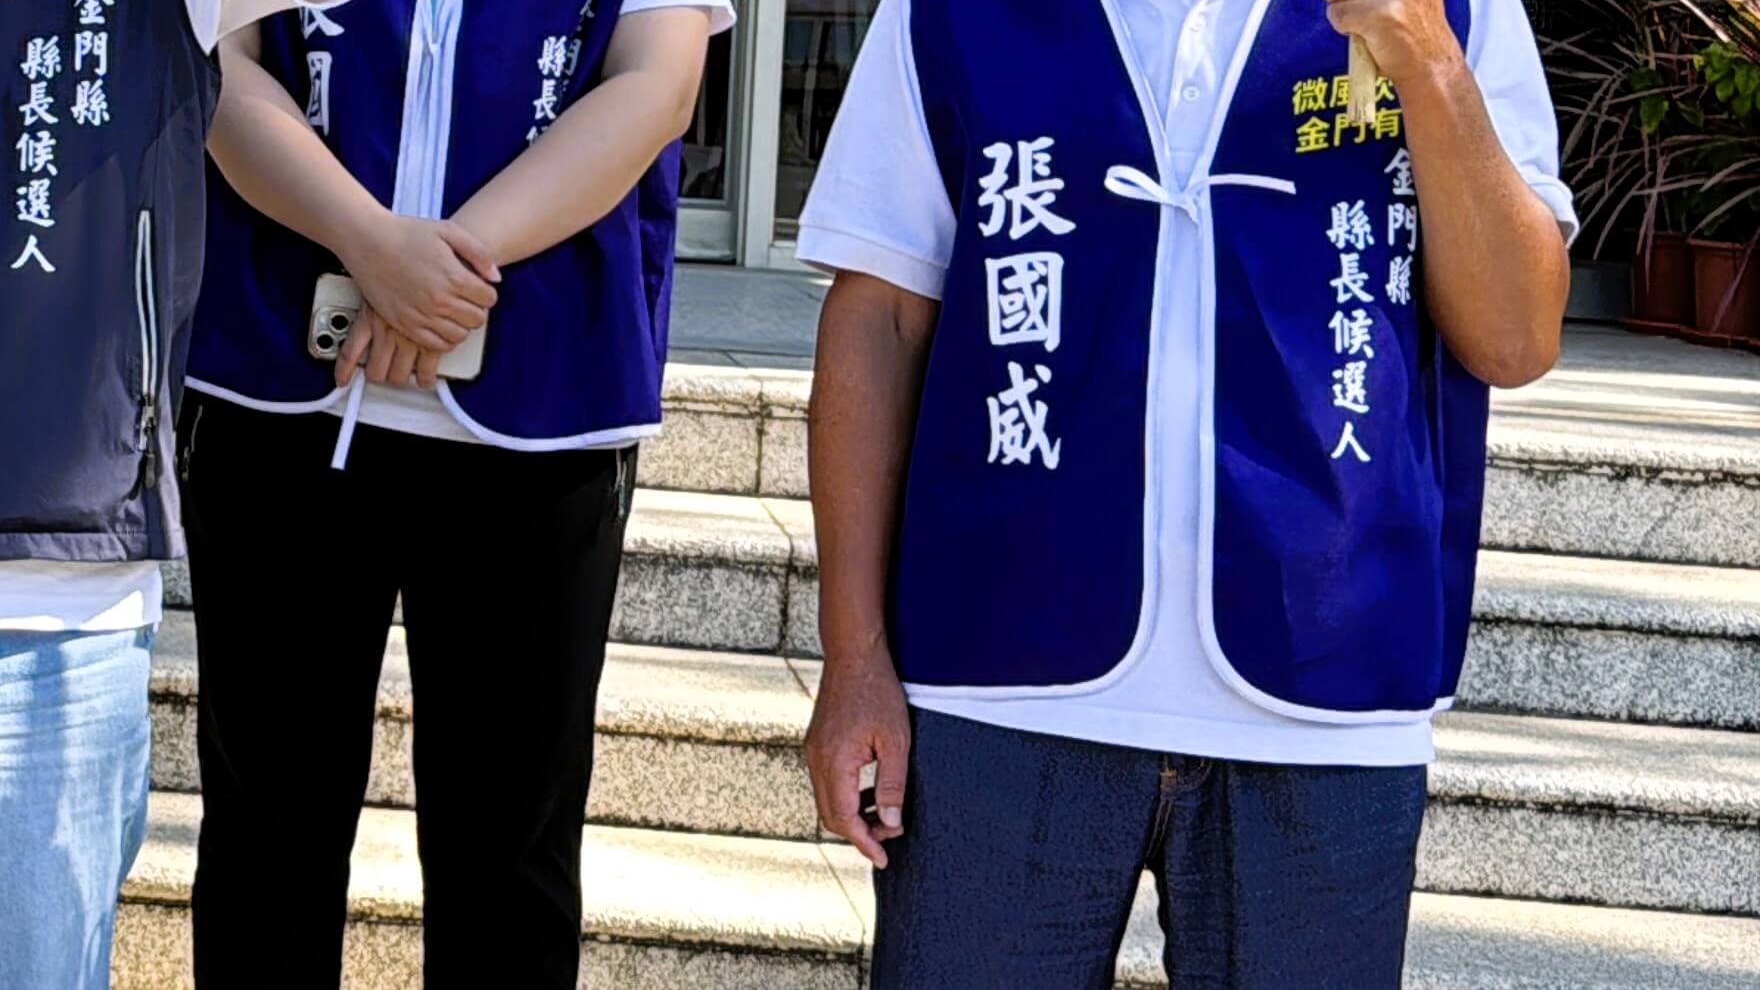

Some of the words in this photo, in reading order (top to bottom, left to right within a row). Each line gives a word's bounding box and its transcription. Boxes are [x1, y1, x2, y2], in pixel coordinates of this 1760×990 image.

[10, 34, 62, 273] 縣長候選人
[1384, 147, 1418, 306] 金門縣
[978, 136, 1076, 470] 張國威
[1326, 199, 1375, 462] 縣長候選人
